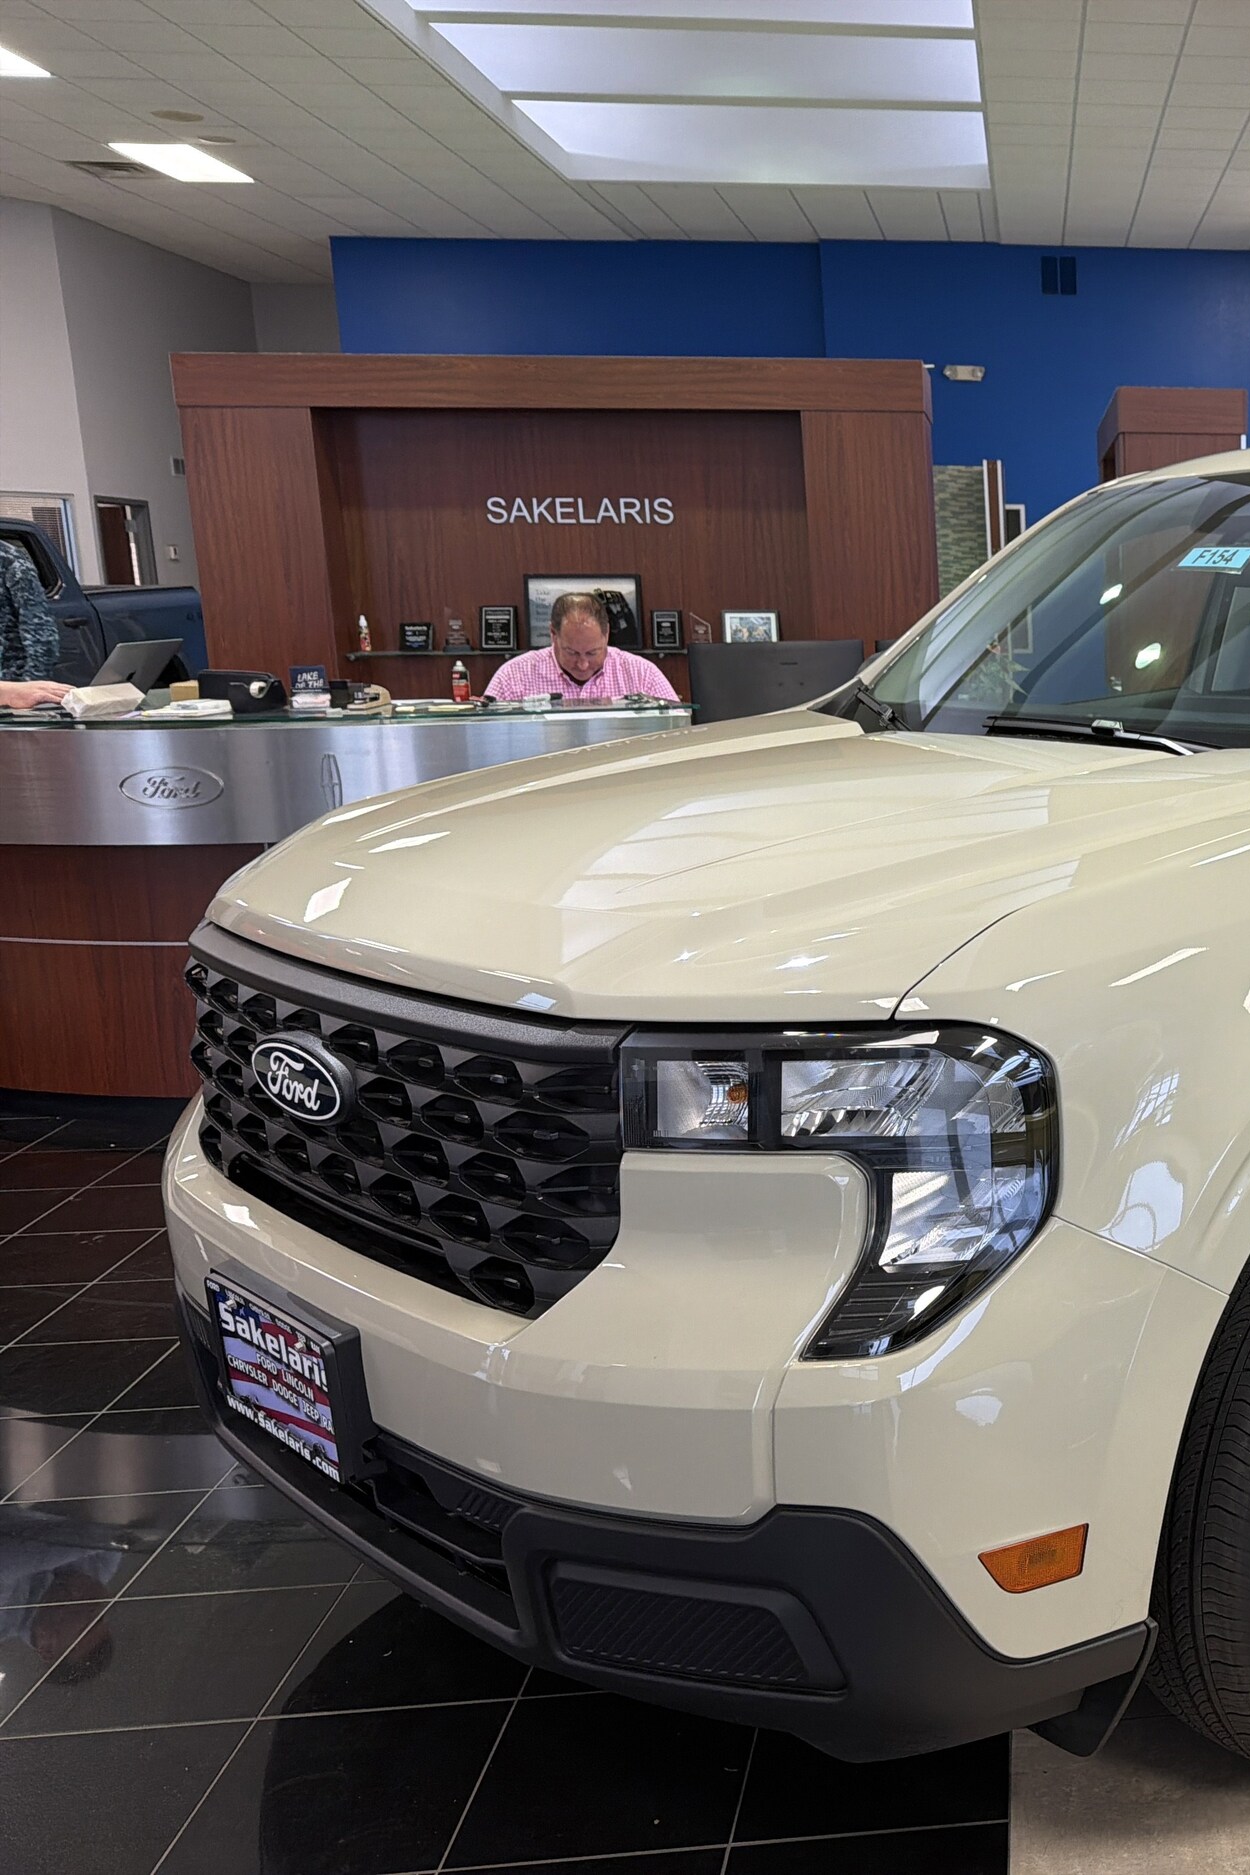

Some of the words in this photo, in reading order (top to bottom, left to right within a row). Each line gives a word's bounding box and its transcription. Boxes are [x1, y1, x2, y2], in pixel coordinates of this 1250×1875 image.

[486, 496, 675, 525] SAKELARIS
[1191, 548, 1240, 566] F154
[297, 671, 319, 683] LAKE
[142, 775, 202, 799] Ford
[267, 1051, 321, 1112] Ford
[256, 1353, 278, 1375] FORD
[281, 1368, 315, 1402] LINCOLN
[227, 1354, 269, 1386] CHRYSLER
[272, 1379, 299, 1407] DODGE
[302, 1399, 321, 1422] JEEP
[322, 1415, 336, 1435] RA
